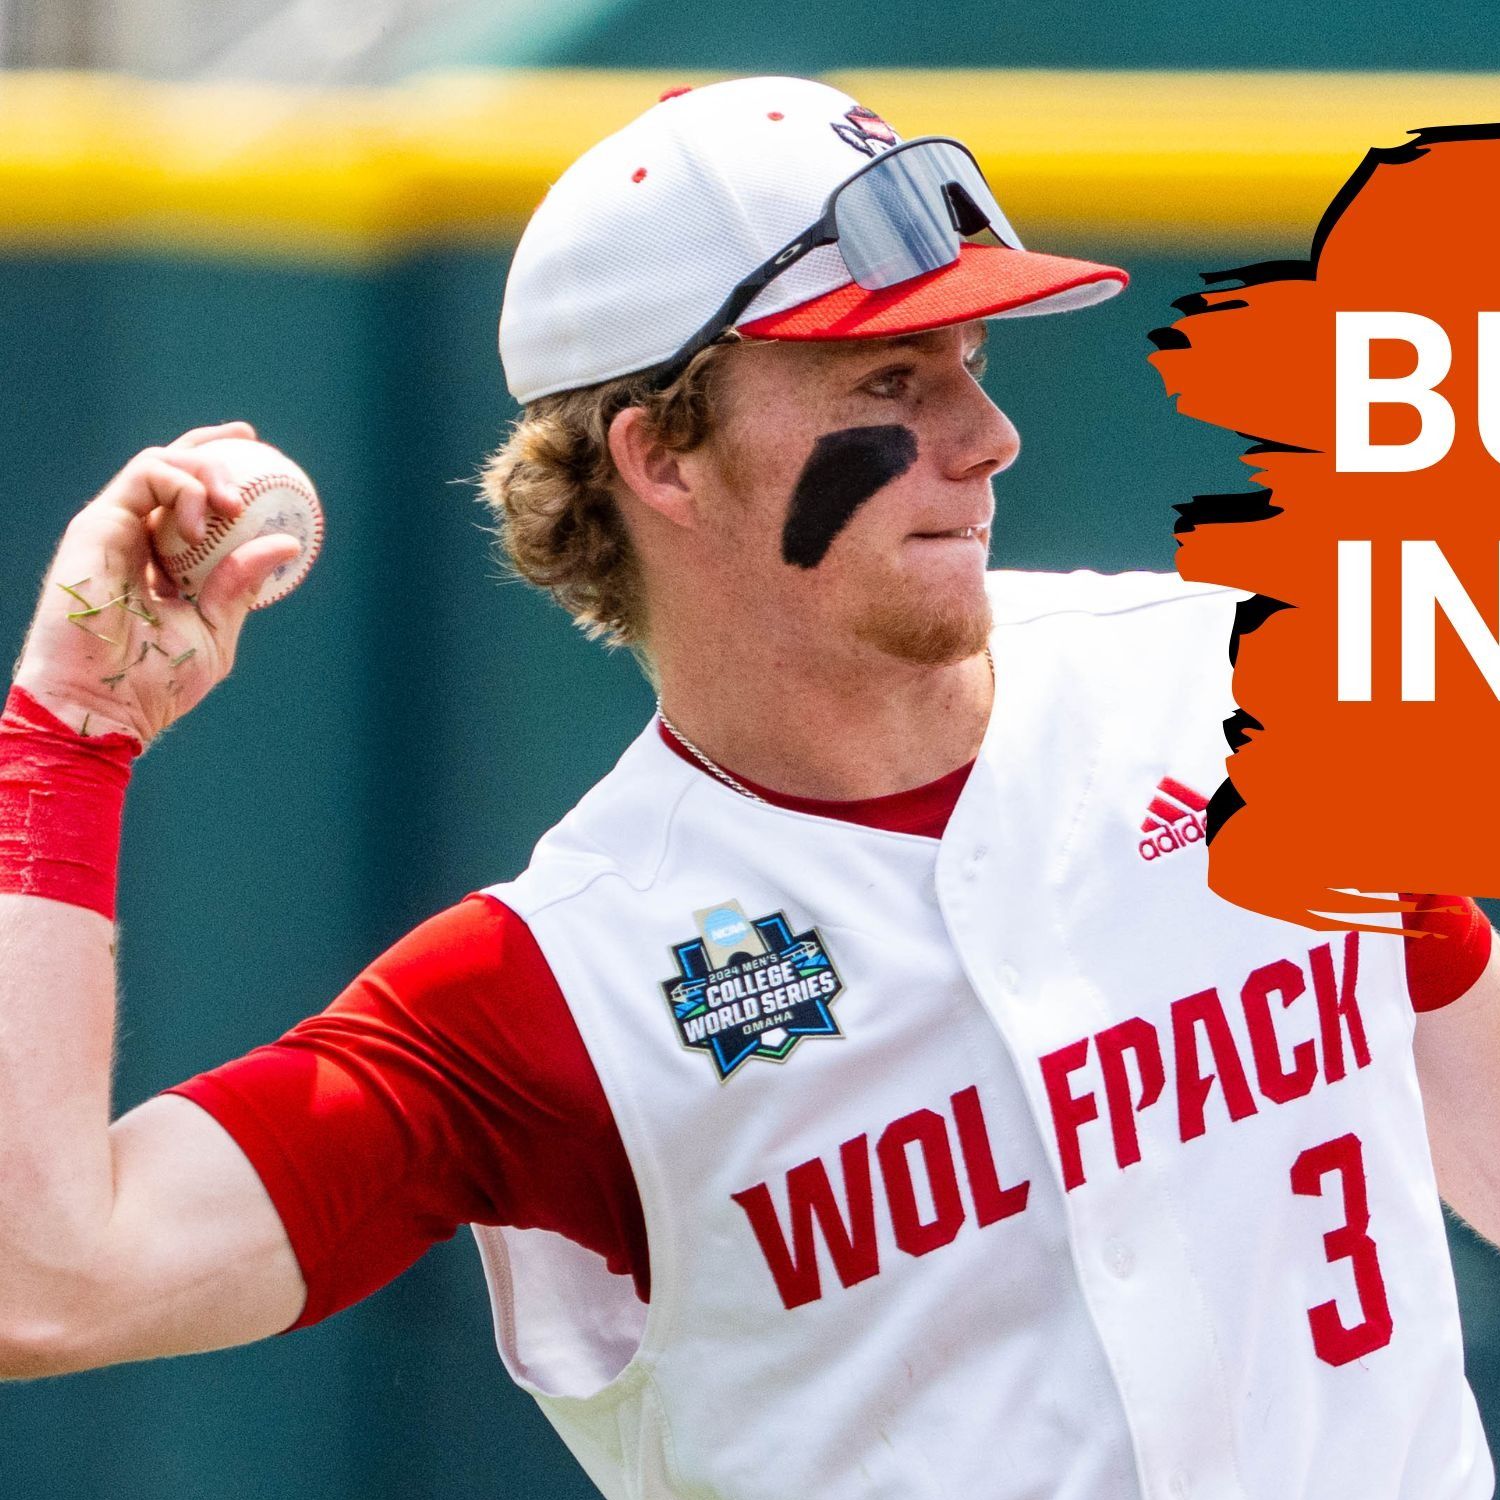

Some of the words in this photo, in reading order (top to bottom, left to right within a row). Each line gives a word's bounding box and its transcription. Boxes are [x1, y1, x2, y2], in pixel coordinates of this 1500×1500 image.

[1138, 812, 1207, 861] adid
[706, 961, 795, 1008] COLLEGE
[708, 966, 739, 984] 2024
[742, 953, 779, 972] MEN'S
[683, 998, 760, 1043] WORLD
[761, 971, 836, 1014] SERIES
[742, 1011, 794, 1035] OMAHA
[1291, 1133, 1393, 1367] 3
